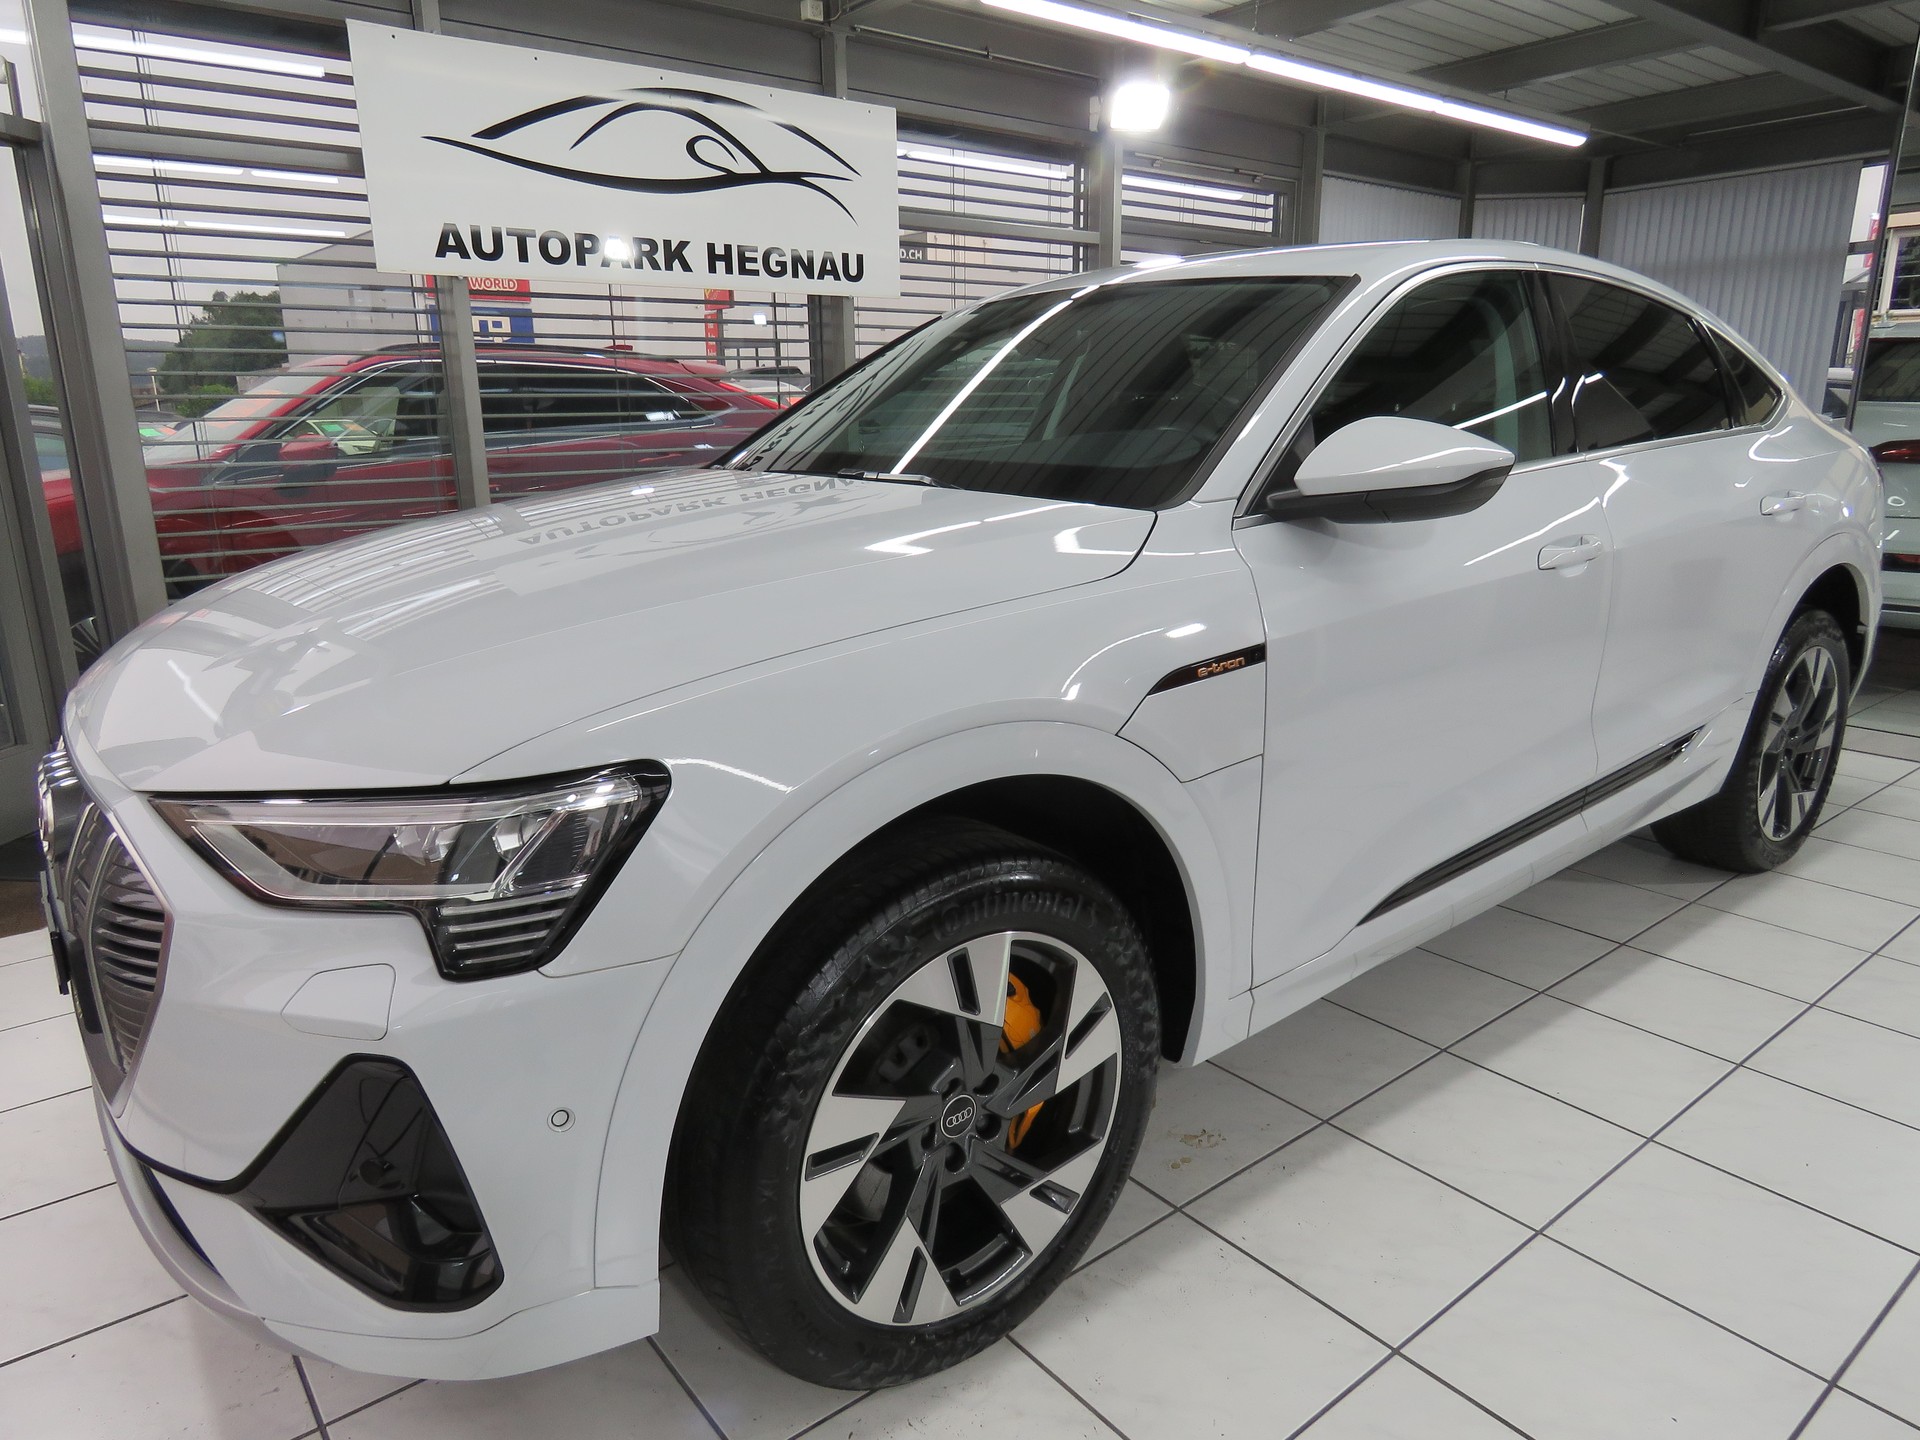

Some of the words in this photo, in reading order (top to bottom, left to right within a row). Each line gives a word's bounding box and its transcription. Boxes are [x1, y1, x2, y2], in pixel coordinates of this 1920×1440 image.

[706, 242, 865, 284] HEGNAU
[469, 277, 518, 291] WORLD
[1197, 656, 1245, 678] e-tron
